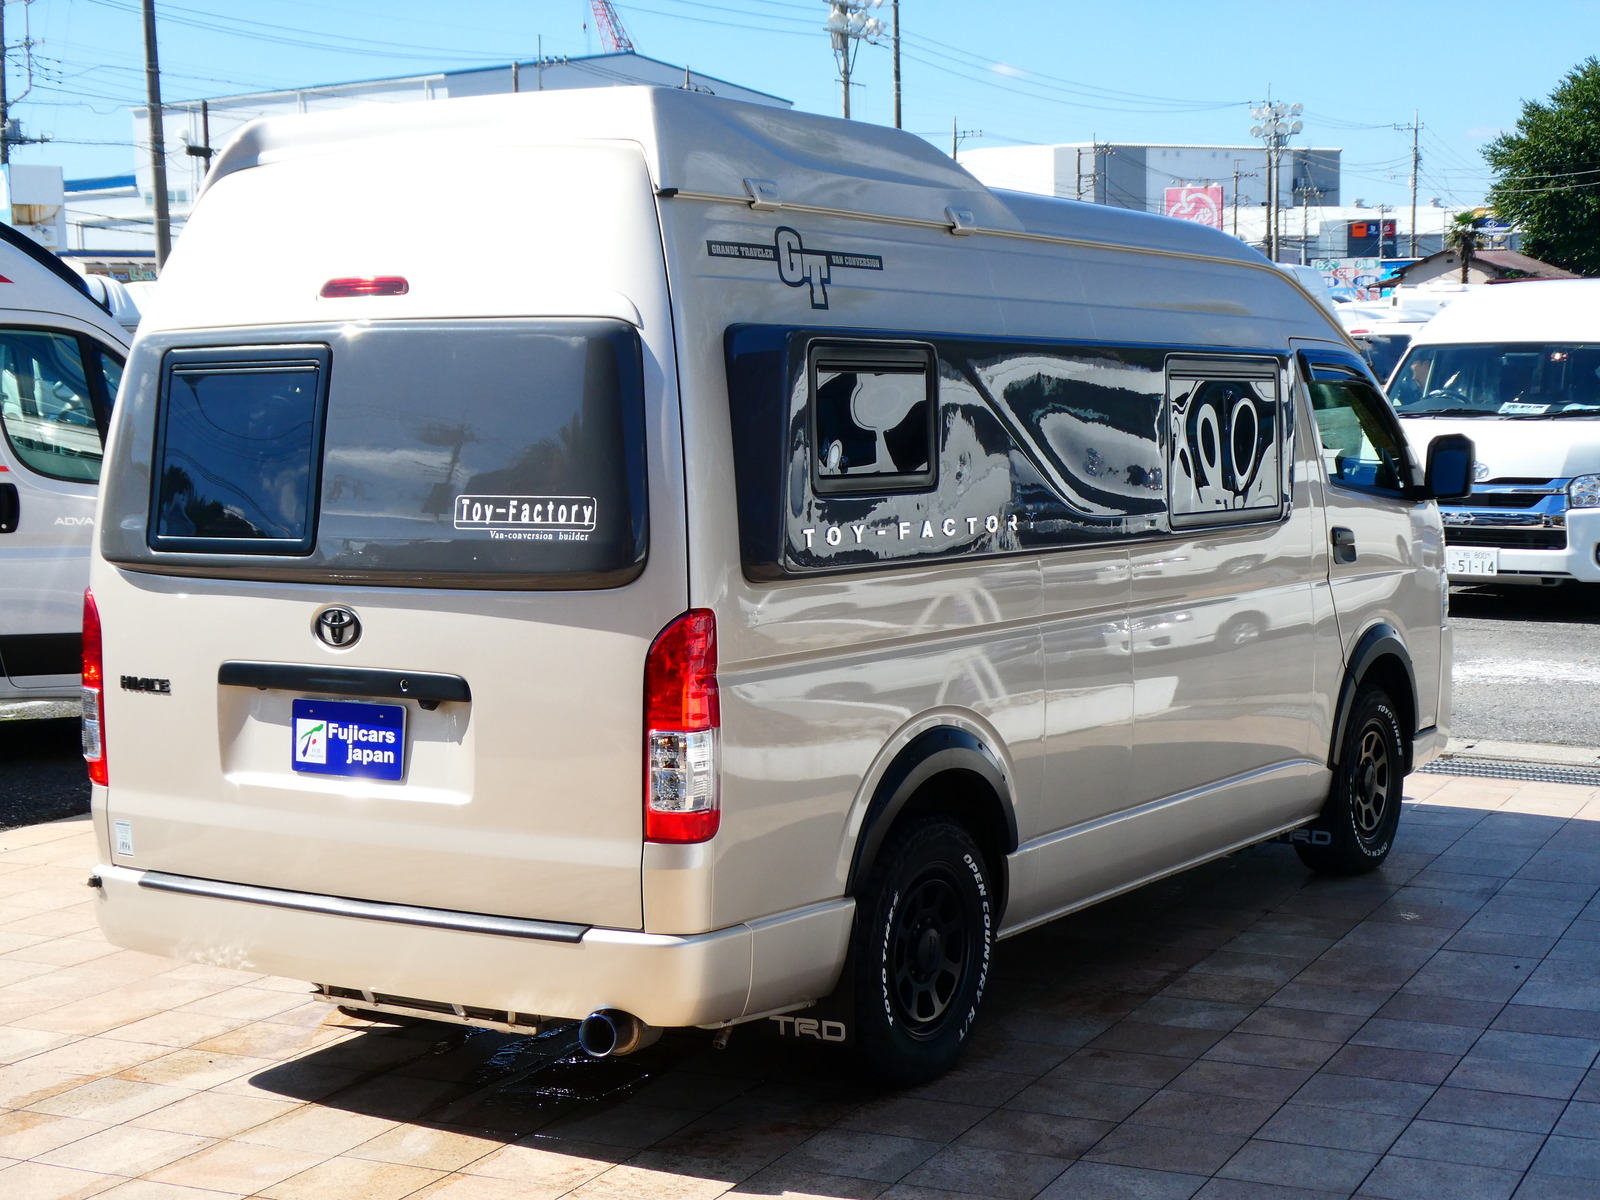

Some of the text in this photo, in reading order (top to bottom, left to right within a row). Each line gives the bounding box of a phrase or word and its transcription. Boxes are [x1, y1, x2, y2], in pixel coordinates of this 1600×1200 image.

[711, 244, 775, 259] GRANDE TRAVELER
[831, 255, 881, 268] VAN CONVERSION
[461, 498, 593, 526] Toy-Factory
[490, 530, 589, 541] Van-conversion builder
[801, 511, 1038, 549] TOY-FACTORY
[1458, 559, 1494, 574] 51-14
[327, 722, 396, 744] Fujicars
[346, 744, 395, 766] japan
[963, 853, 987, 897] OPEN
[977, 901, 992, 1004] COUNTRY
[881, 967, 894, 1027] TOYO
[768, 1015, 847, 1042] TRD
